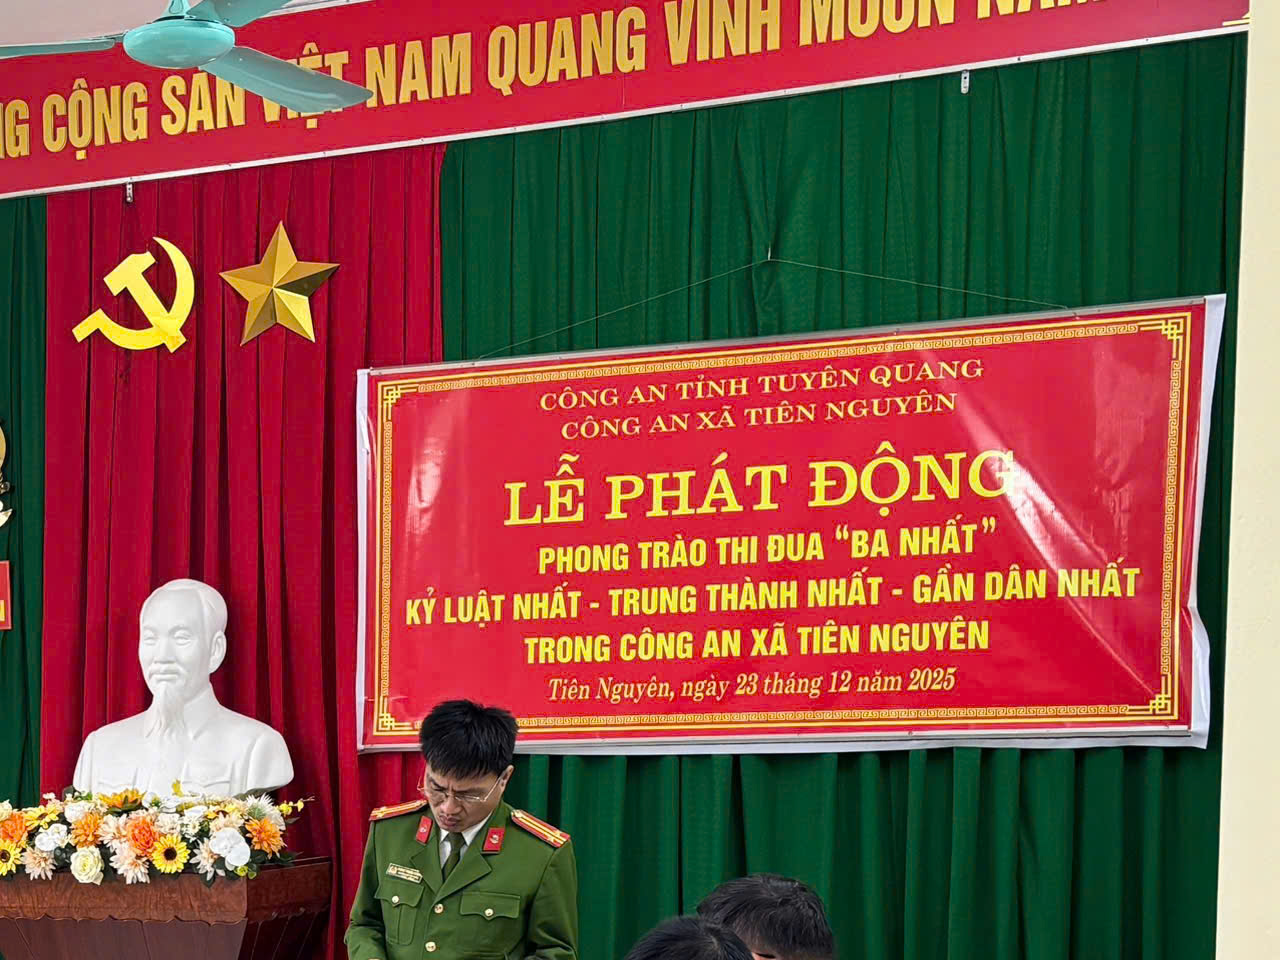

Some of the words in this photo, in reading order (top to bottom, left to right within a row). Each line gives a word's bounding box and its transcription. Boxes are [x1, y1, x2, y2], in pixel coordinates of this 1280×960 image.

[42, 78, 148, 160] CỘNG
[365, 32, 471, 108] NAM
[487, 6, 646, 96] QUANG
[664, 0, 781, 65] VINH
[540, 386, 618, 410] CÔNG
[629, 384, 667, 404] AN
[675, 375, 748, 400] TỈNH
[758, 365, 860, 393] TUYÊN
[870, 359, 983, 387] QUANG
[561, 416, 641, 440] CÔNG
[650, 413, 689, 434] AN
[696, 406, 736, 430] XÃ
[744, 401, 815, 425] TIÊN
[825, 388, 957, 421] NGUYÊN
[503, 453, 585, 526] LỄ
[605, 452, 787, 520] PHÁT
[809, 441, 1015, 516] ĐỘNG
[539, 543, 629, 574] PHONG
[638, 534, 707, 569] TRÀO
[716, 535, 757, 565] THI
[766, 533, 824, 562] ĐUA
[406, 586, 435, 625] KỶ
[443, 590, 505, 627] LUẬT
[513, 582, 581, 620] NHẤT
[609, 588, 696, 616] TRUNG
[706, 577, 797, 611] THÀNH
[807, 567, 883, 608] NHẤT
[914, 563, 975, 603] GẦN
[985, 565, 1047, 600] DÂN
[1057, 556, 1140, 598] NHẤT
[524, 636, 610, 664] TRONG
[620, 628, 692, 661] CÔNG
[702, 630, 741, 658] AN
[751, 622, 787, 657] XÃ
[797, 620, 860, 655] TIÊN
[870, 616, 989, 653] NGUYÊN
[548, 677, 590, 701] Tiên
[680, 677, 730, 706] ngày
[736, 673, 757, 696] 23
[764, 672, 824, 699] tháng
[828, 670, 852, 693] 12
[857, 671, 902, 692] năm
[907, 667, 956, 691] 2025
